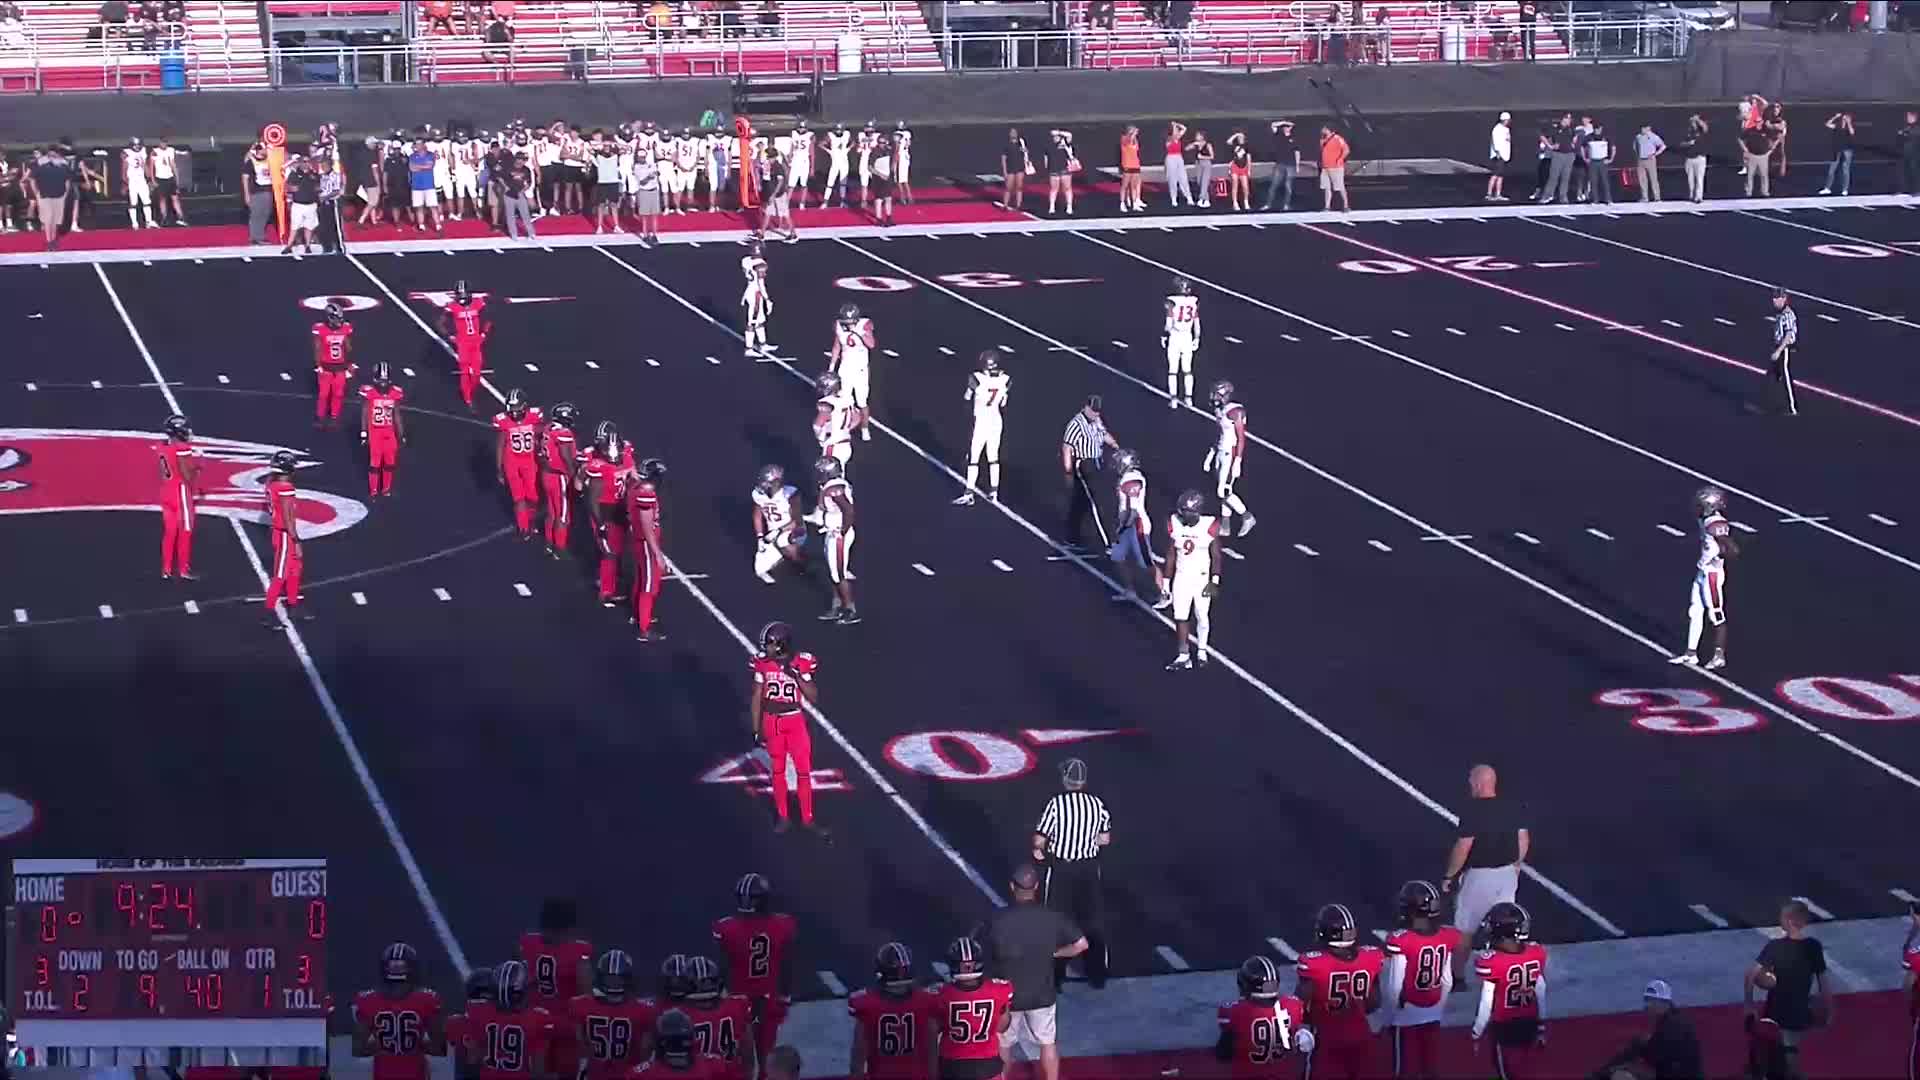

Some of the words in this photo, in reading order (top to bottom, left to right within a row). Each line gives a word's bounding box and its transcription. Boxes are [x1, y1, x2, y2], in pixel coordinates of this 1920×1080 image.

[1177, 306, 1193, 322] 13
[847, 333, 856, 347] 6
[986, 388, 999, 407] 7
[510, 431, 534, 453] 56
[1183, 539, 1195, 556] 9
[766, 681, 799, 703] 29
[1594, 673, 1920, 734] 30
[535, 954, 558, 996] 9
[749, 933, 770, 978] 2
[1415, 943, 1447, 990] 81
[1327, 969, 1371, 1012] 59
[1504, 963, 1540, 1009] 25
[375, 1011, 421, 1056] 26
[586, 1015, 632, 1060] 58
[693, 1016, 739, 1064] 74
[878, 1013, 915, 1056] 61
[948, 999, 995, 1043] 57
[485, 1023, 525, 1072] 19
